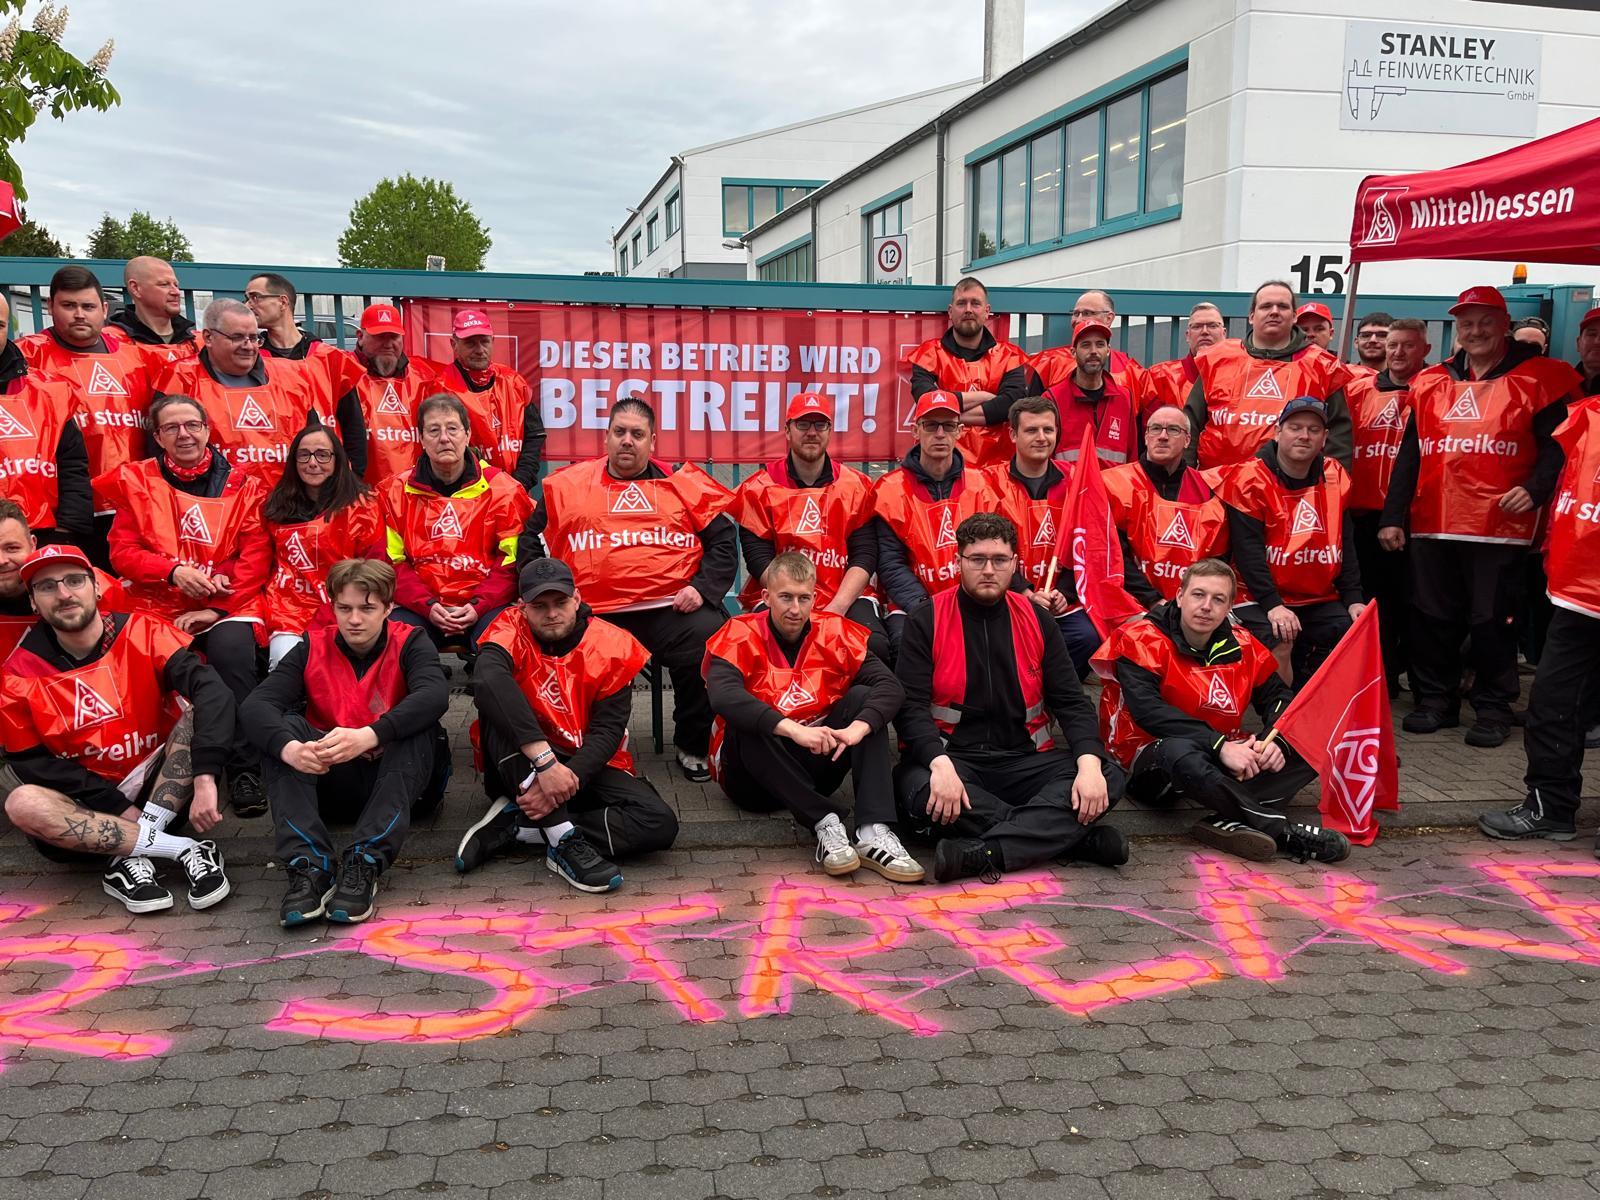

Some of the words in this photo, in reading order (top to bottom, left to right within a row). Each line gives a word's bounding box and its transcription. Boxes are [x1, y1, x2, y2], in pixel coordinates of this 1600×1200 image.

[1378, 60, 1535, 86] FEINWERKTECHNIK
[1506, 90, 1535, 101] GmbH
[1410, 186, 1575, 229] Mittelhessen
[884, 248, 896, 264] 12
[1290, 255, 1344, 294] 15
[540, 340, 651, 370] DIESER
[661, 344, 790, 372] BETRIEB
[800, 346, 881, 374] WIRD
[1436, 433, 1518, 457] streiken
[567, 528, 602, 553] Wir
[609, 526, 695, 549] streiken
